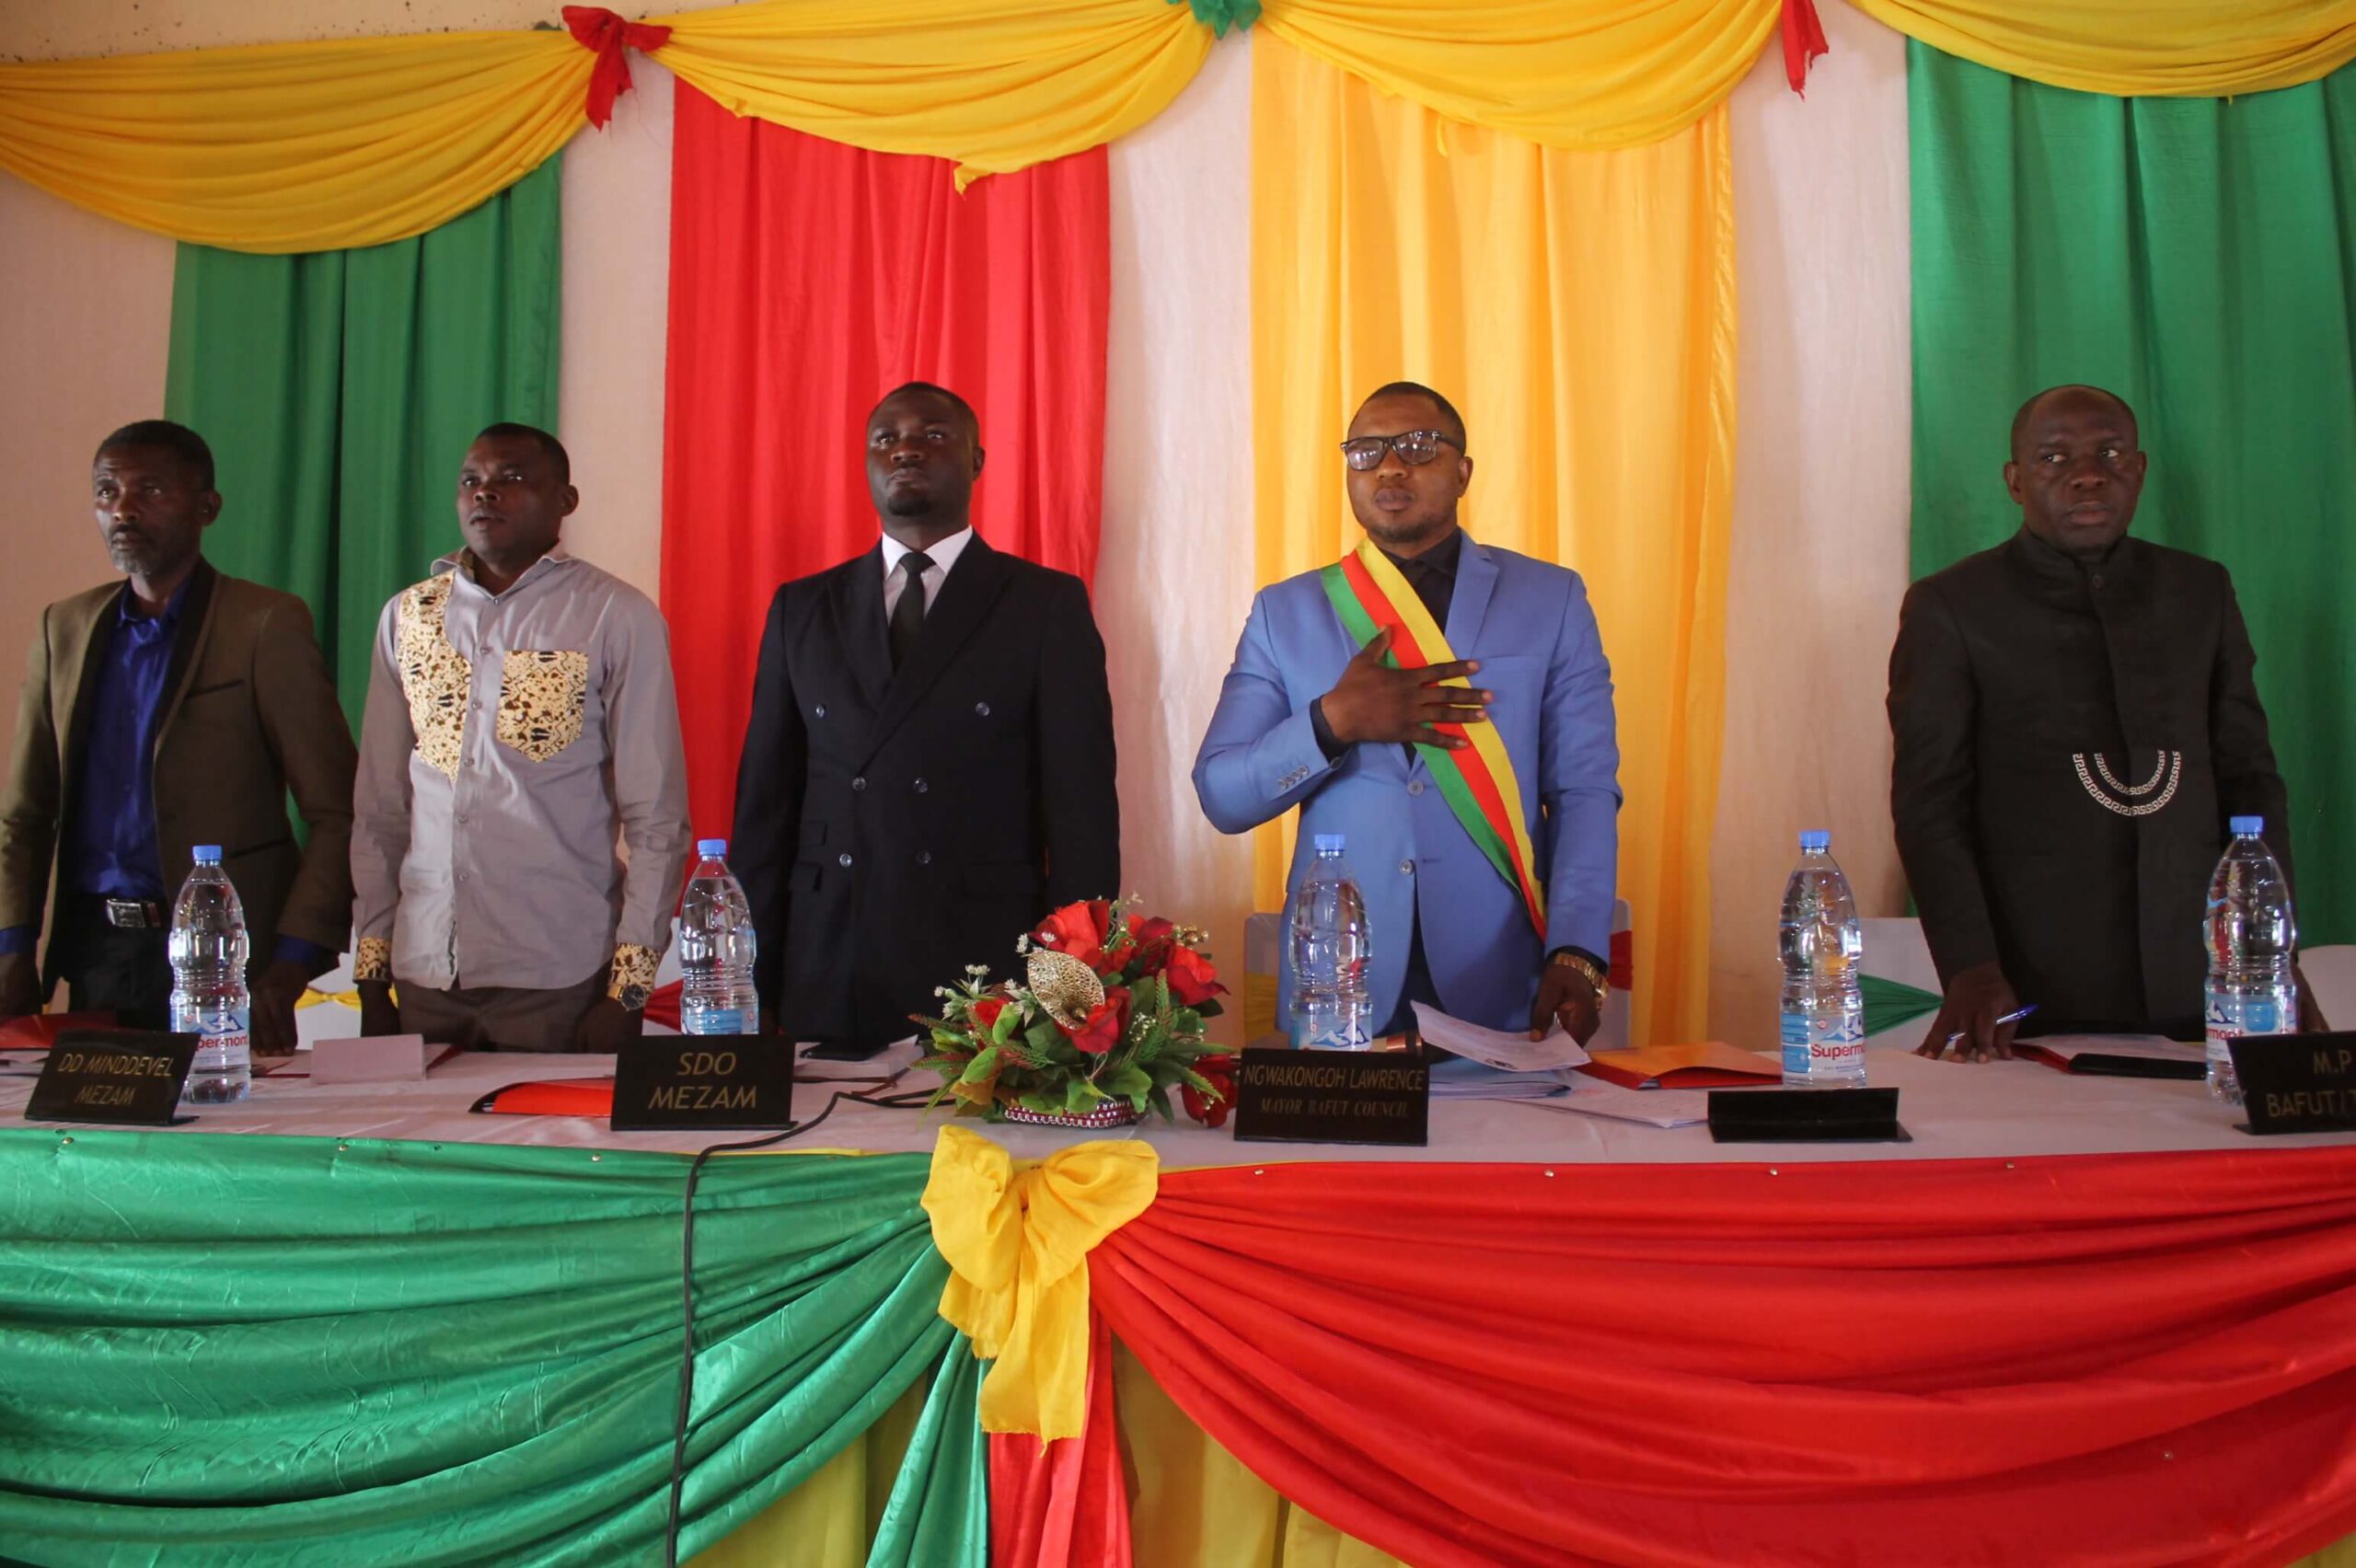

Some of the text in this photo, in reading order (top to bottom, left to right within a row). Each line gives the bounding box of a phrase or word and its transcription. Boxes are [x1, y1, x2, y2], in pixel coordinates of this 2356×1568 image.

[57, 1053, 85, 1073] DD
[84, 1054, 175, 1077] MINDDEVEL
[677, 1052, 736, 1077] SDO
[1242, 1065, 1426, 1091] NGWAKONGOH LAWRENCE
[74, 1084, 137, 1105] MEZAM
[647, 1085, 757, 1110] MEZAM
[1259, 1098, 1410, 1118] MAYOR BAFUT COUNCIL
